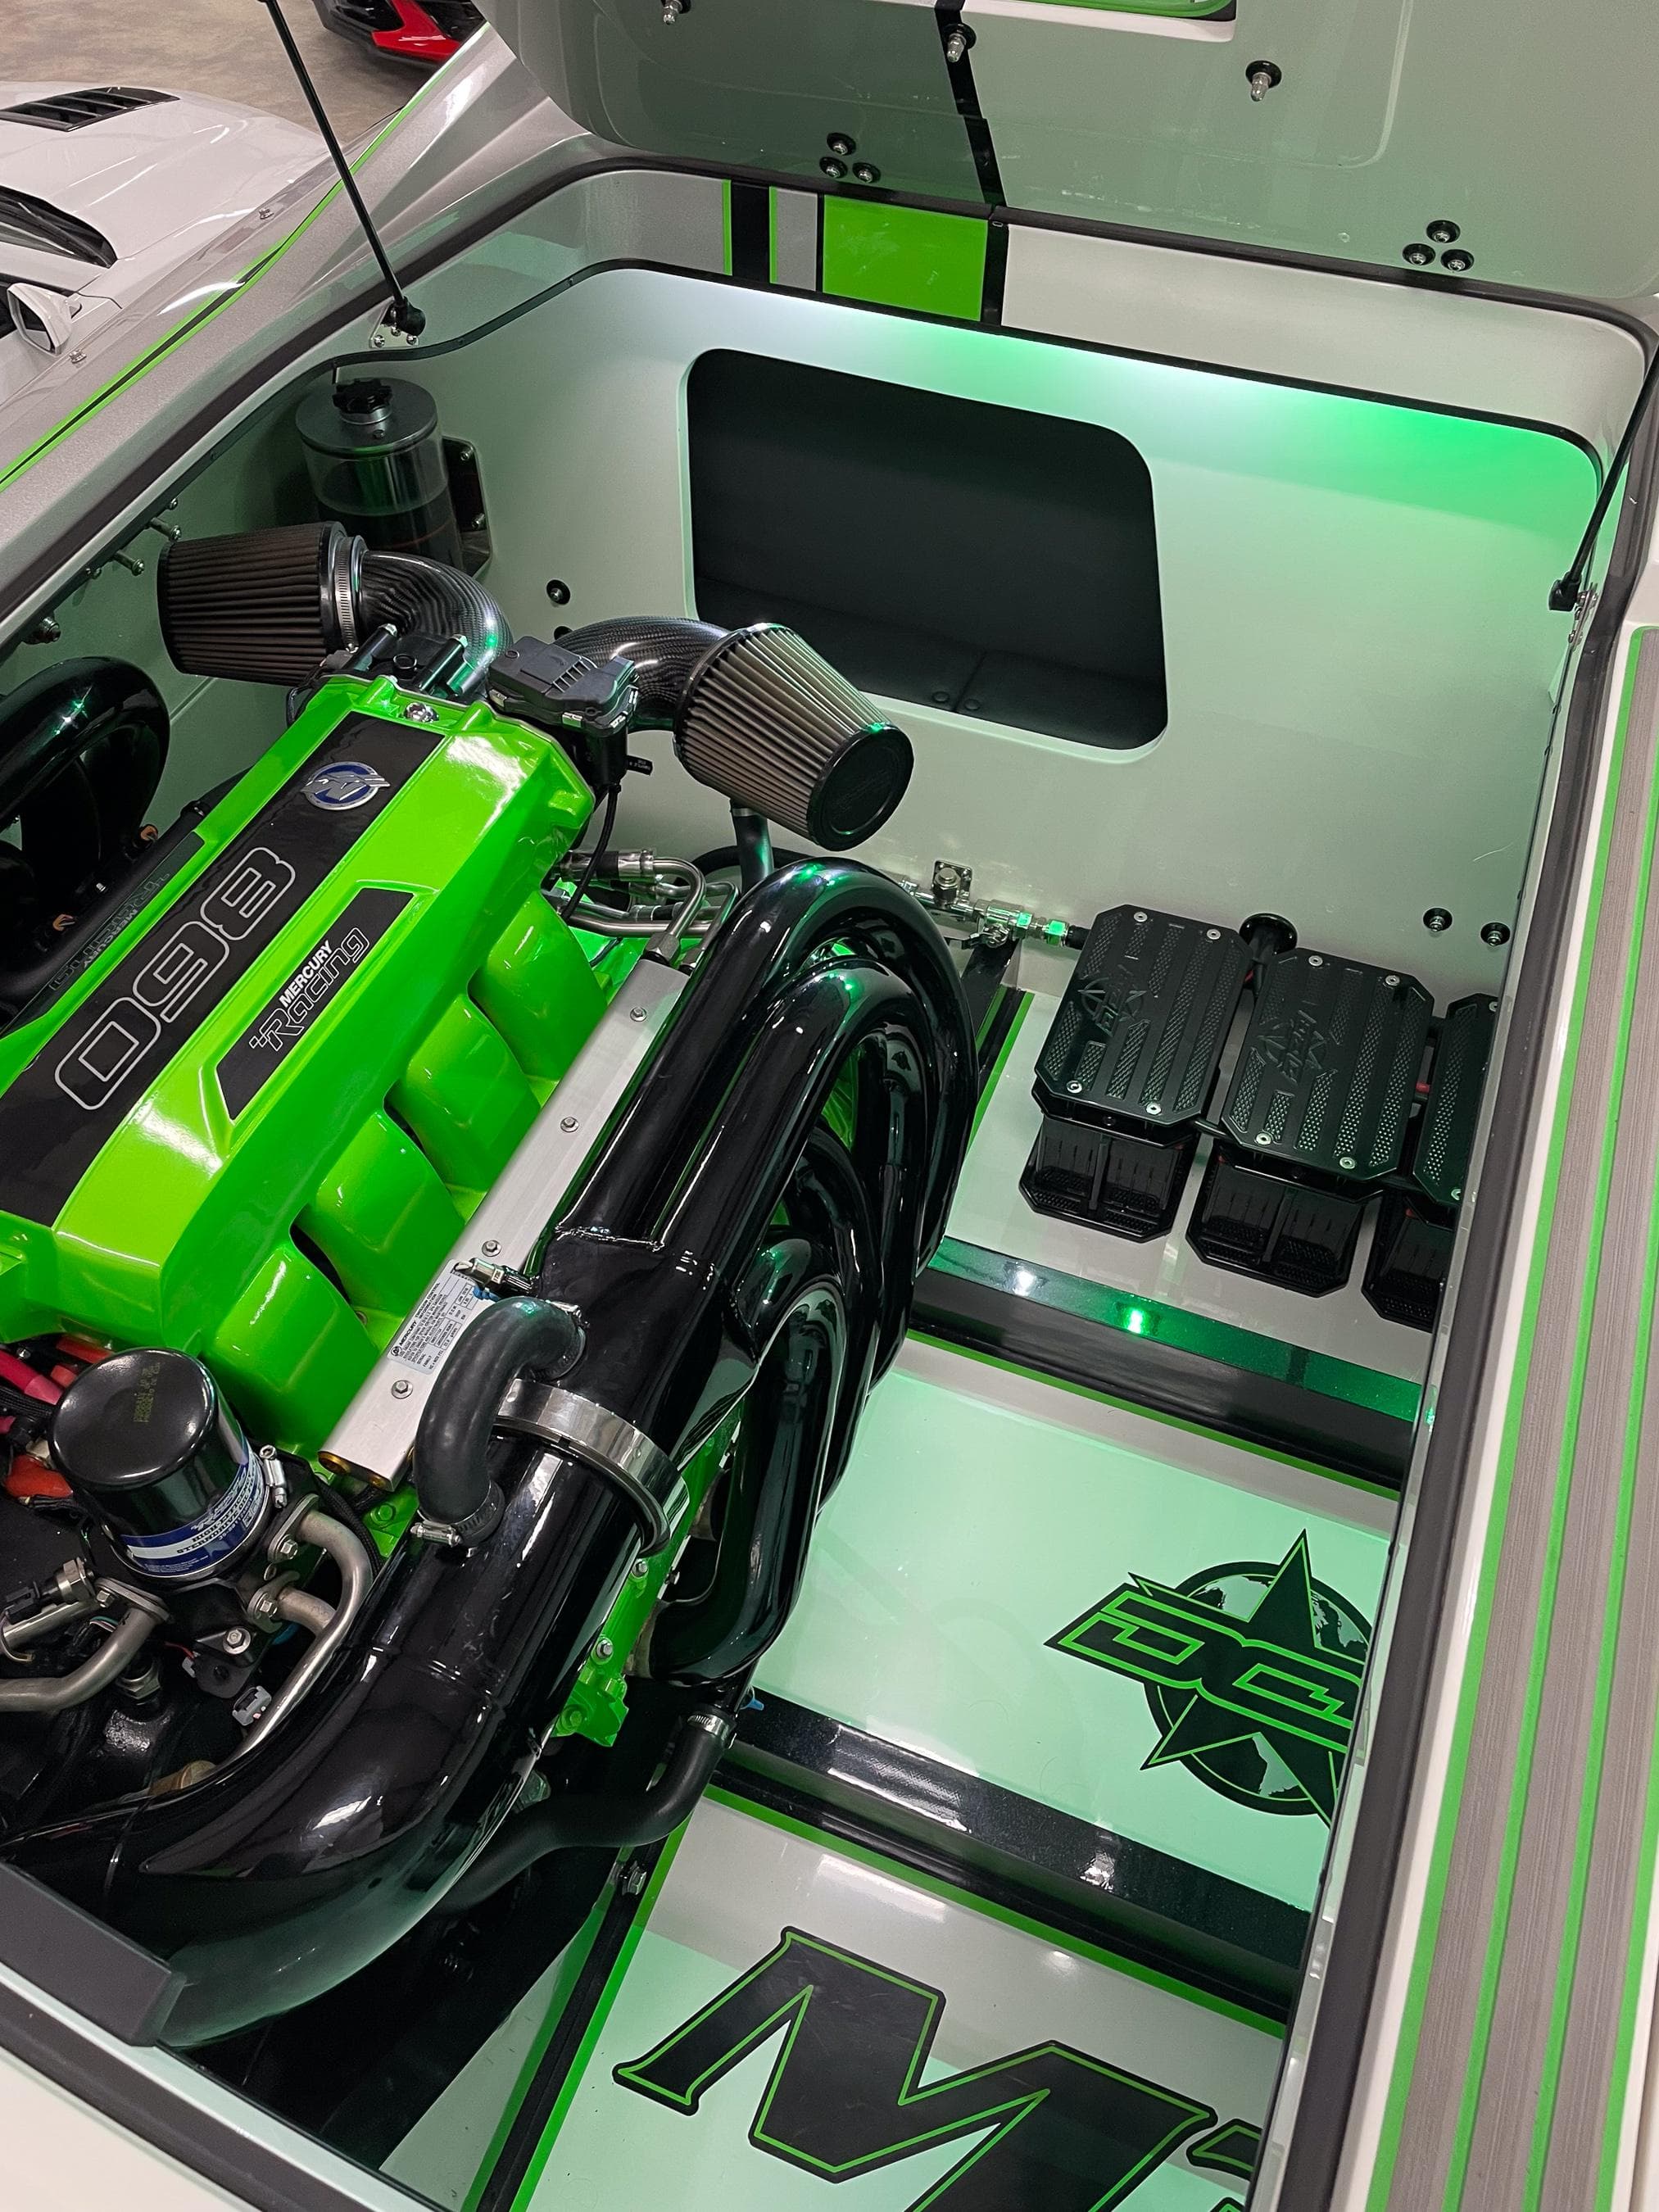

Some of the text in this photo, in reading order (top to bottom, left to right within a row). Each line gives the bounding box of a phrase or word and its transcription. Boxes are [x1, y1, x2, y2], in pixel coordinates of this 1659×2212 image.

[83, 909, 138, 968] MERCURY
[249, 927, 370, 1051] Racing
[279, 940, 334, 1008] MERCURY
[399, 1321, 417, 1346] MERCURY
